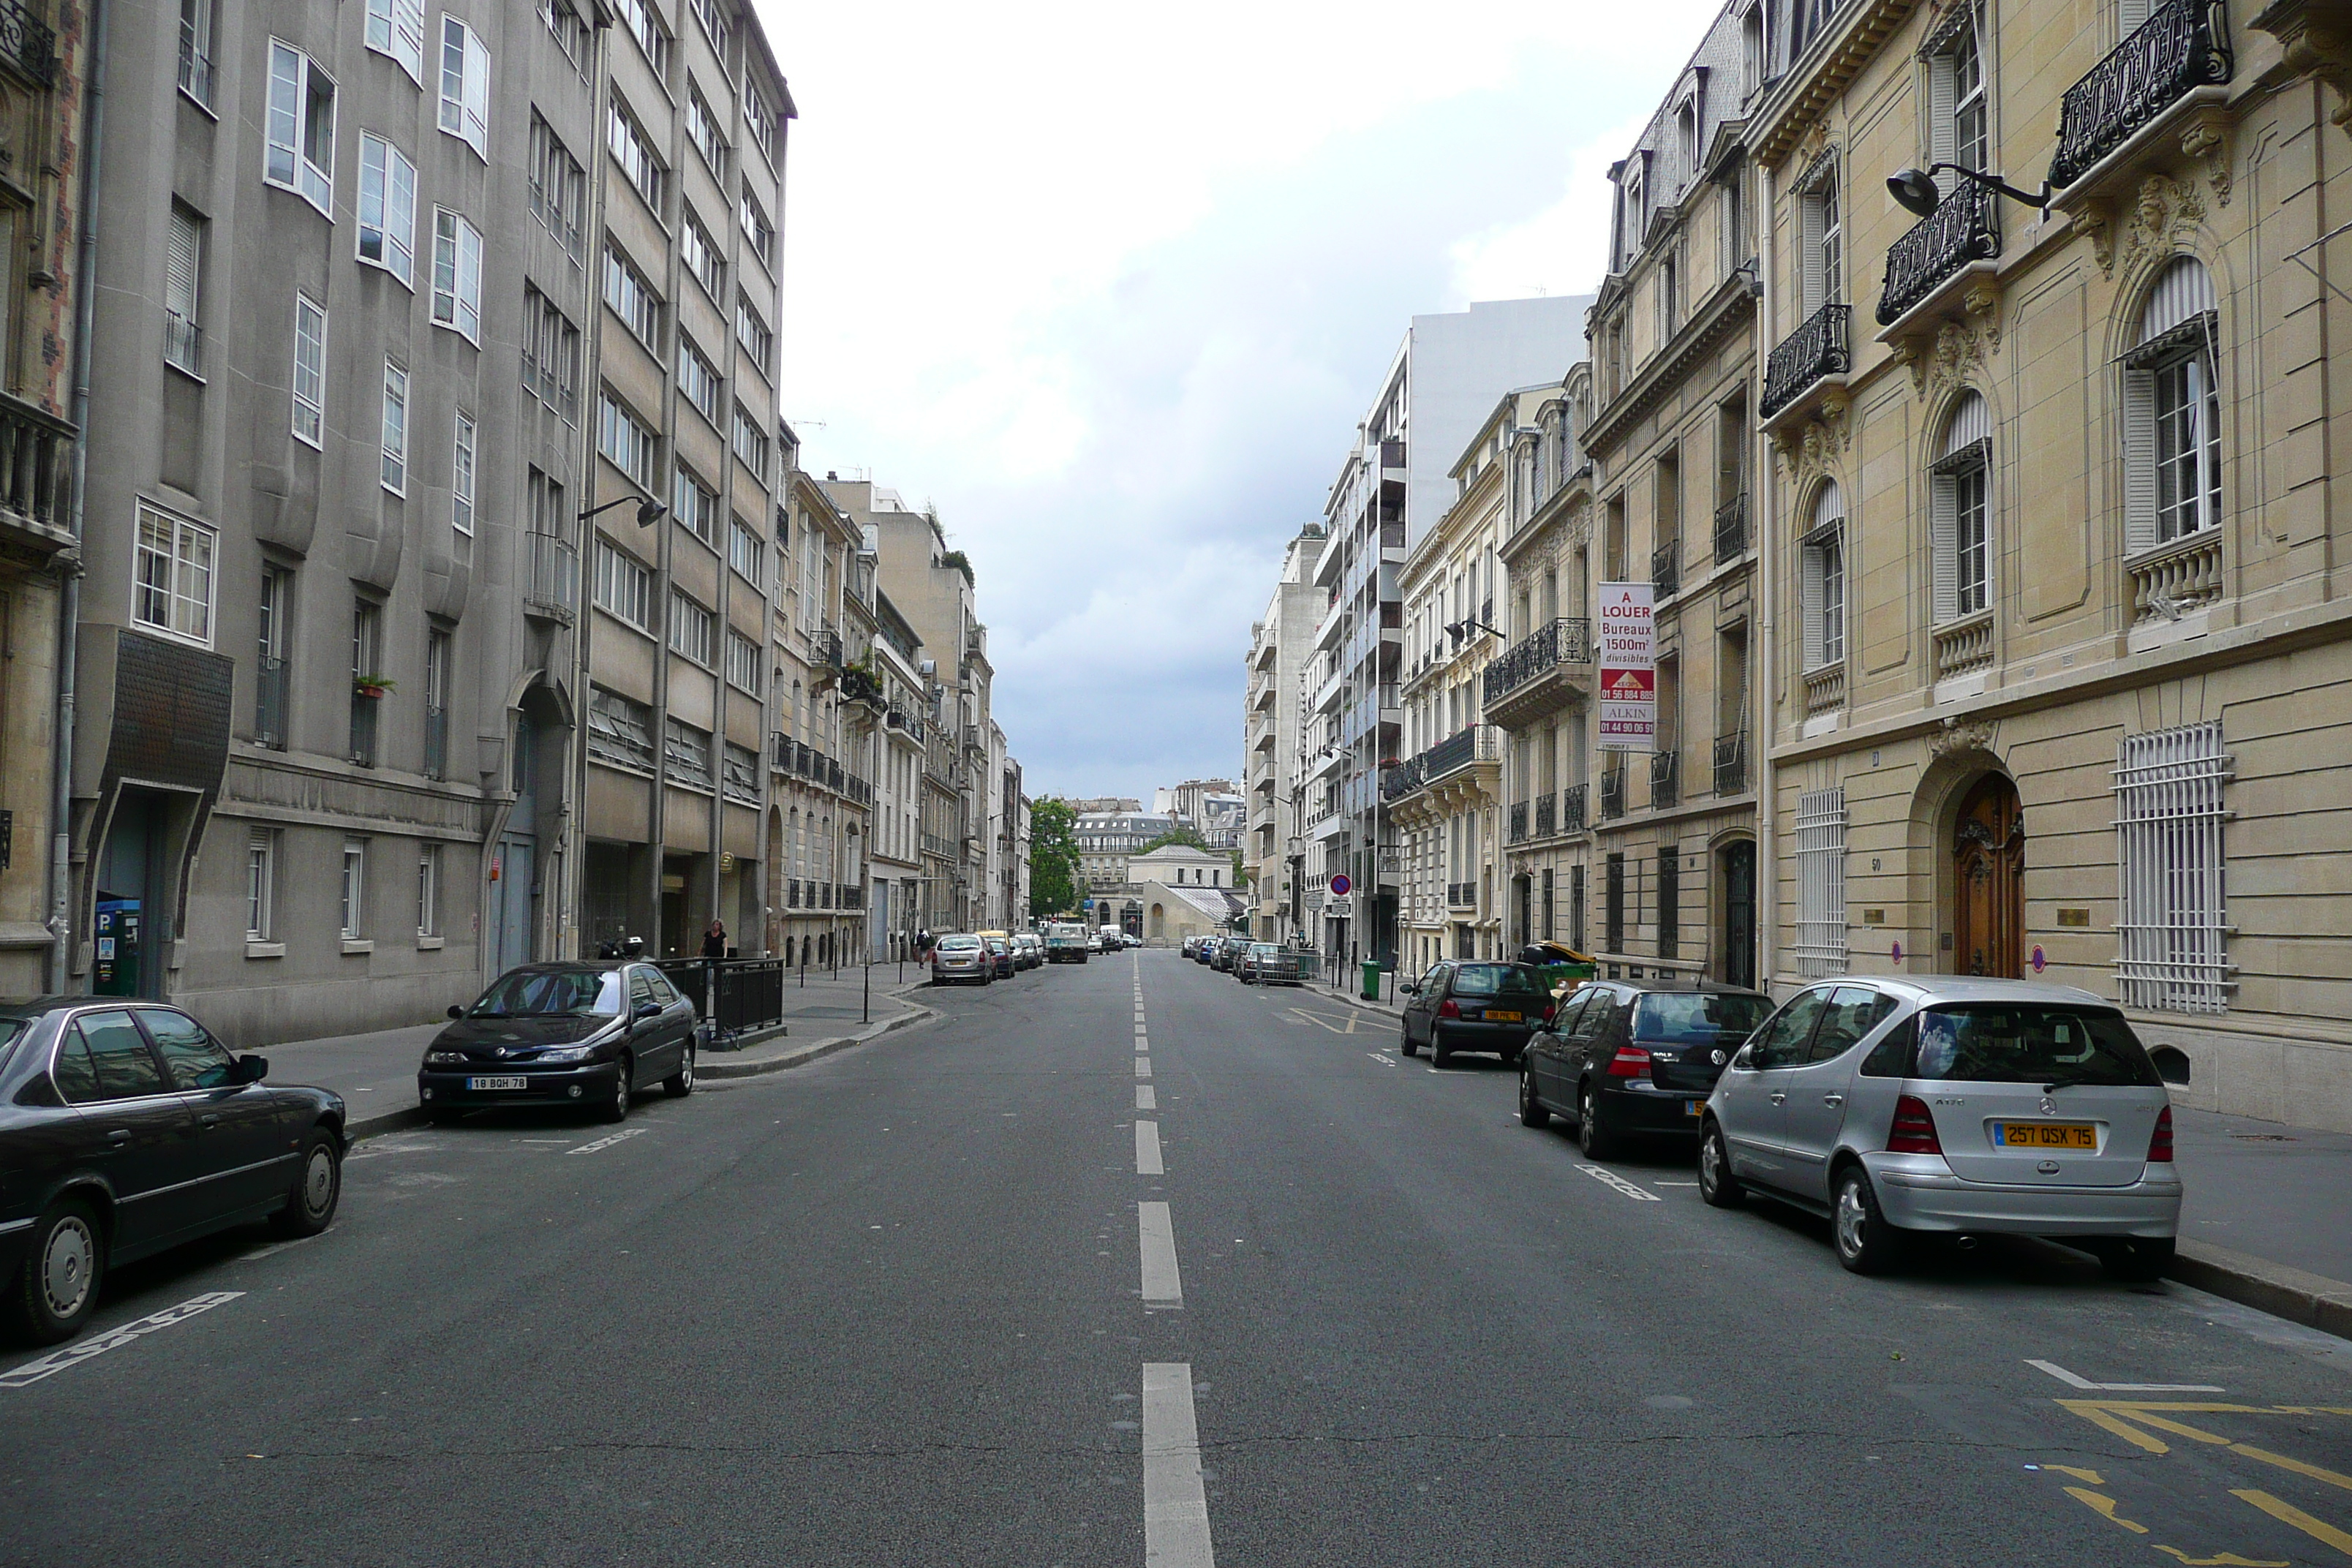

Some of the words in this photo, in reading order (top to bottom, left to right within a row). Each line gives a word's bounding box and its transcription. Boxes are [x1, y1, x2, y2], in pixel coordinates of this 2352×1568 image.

[1621, 592, 1632, 603] A
[1602, 606, 1651, 618] LOUER
[1602, 622, 1651, 636] Bureaux
[1606, 653, 1649, 663] divisibles
[1602, 689, 1610, 698] 01
[1613, 690, 1622, 699] 56
[1609, 708, 1646, 719] ALKIN
[1601, 723, 1609, 731] 01
[1612, 723, 1621, 732] 44
[1623, 723, 1632, 732] 90
[1635, 723, 1643, 732] 06
[1645, 723, 1653, 733] 91
[475, 1079, 486, 1088] 18
[490, 1079, 508, 1088] BQH
[512, 1078, 524, 1088] 78
[2009, 1127, 2035, 1143] 257
[2041, 1128, 2068, 1144] QSX
[2073, 1129, 2092, 1145] 75
